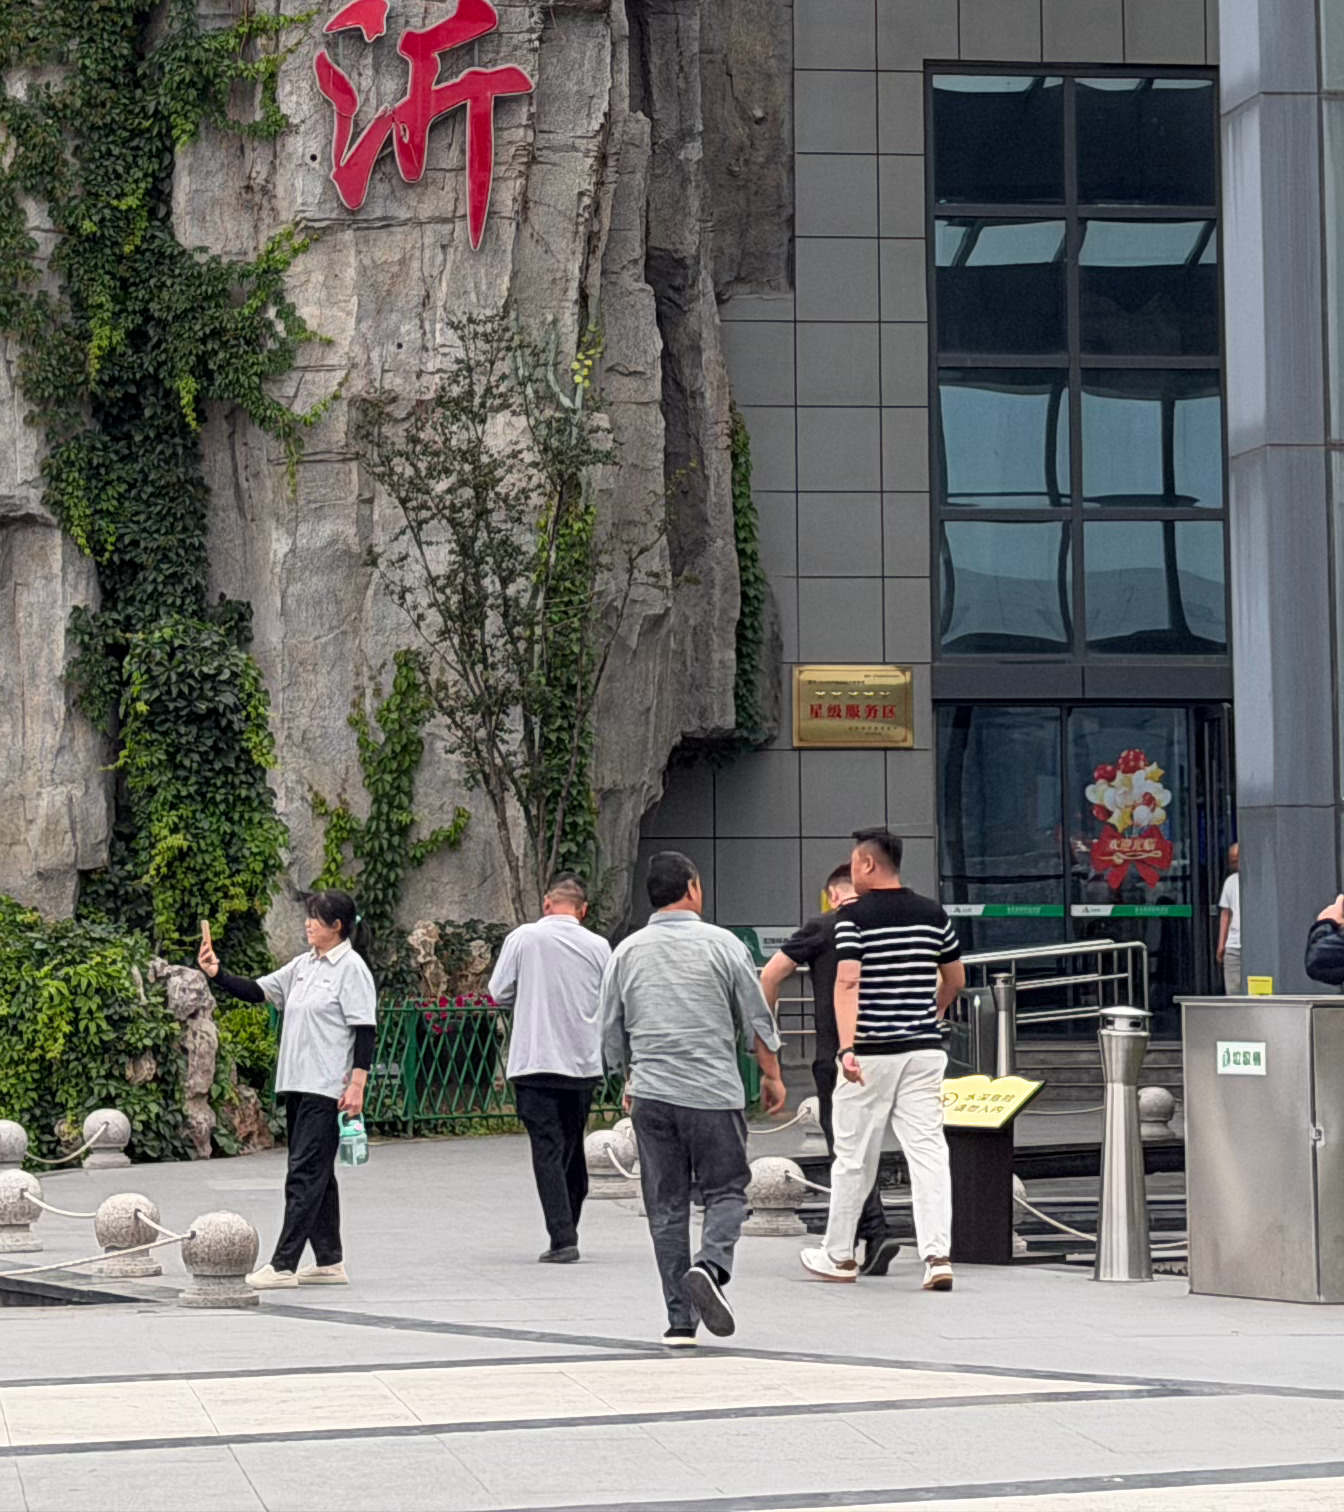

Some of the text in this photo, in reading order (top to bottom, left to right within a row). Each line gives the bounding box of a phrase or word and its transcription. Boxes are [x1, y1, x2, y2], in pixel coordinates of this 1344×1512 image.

[809, 703, 897, 720] 星级服务区
